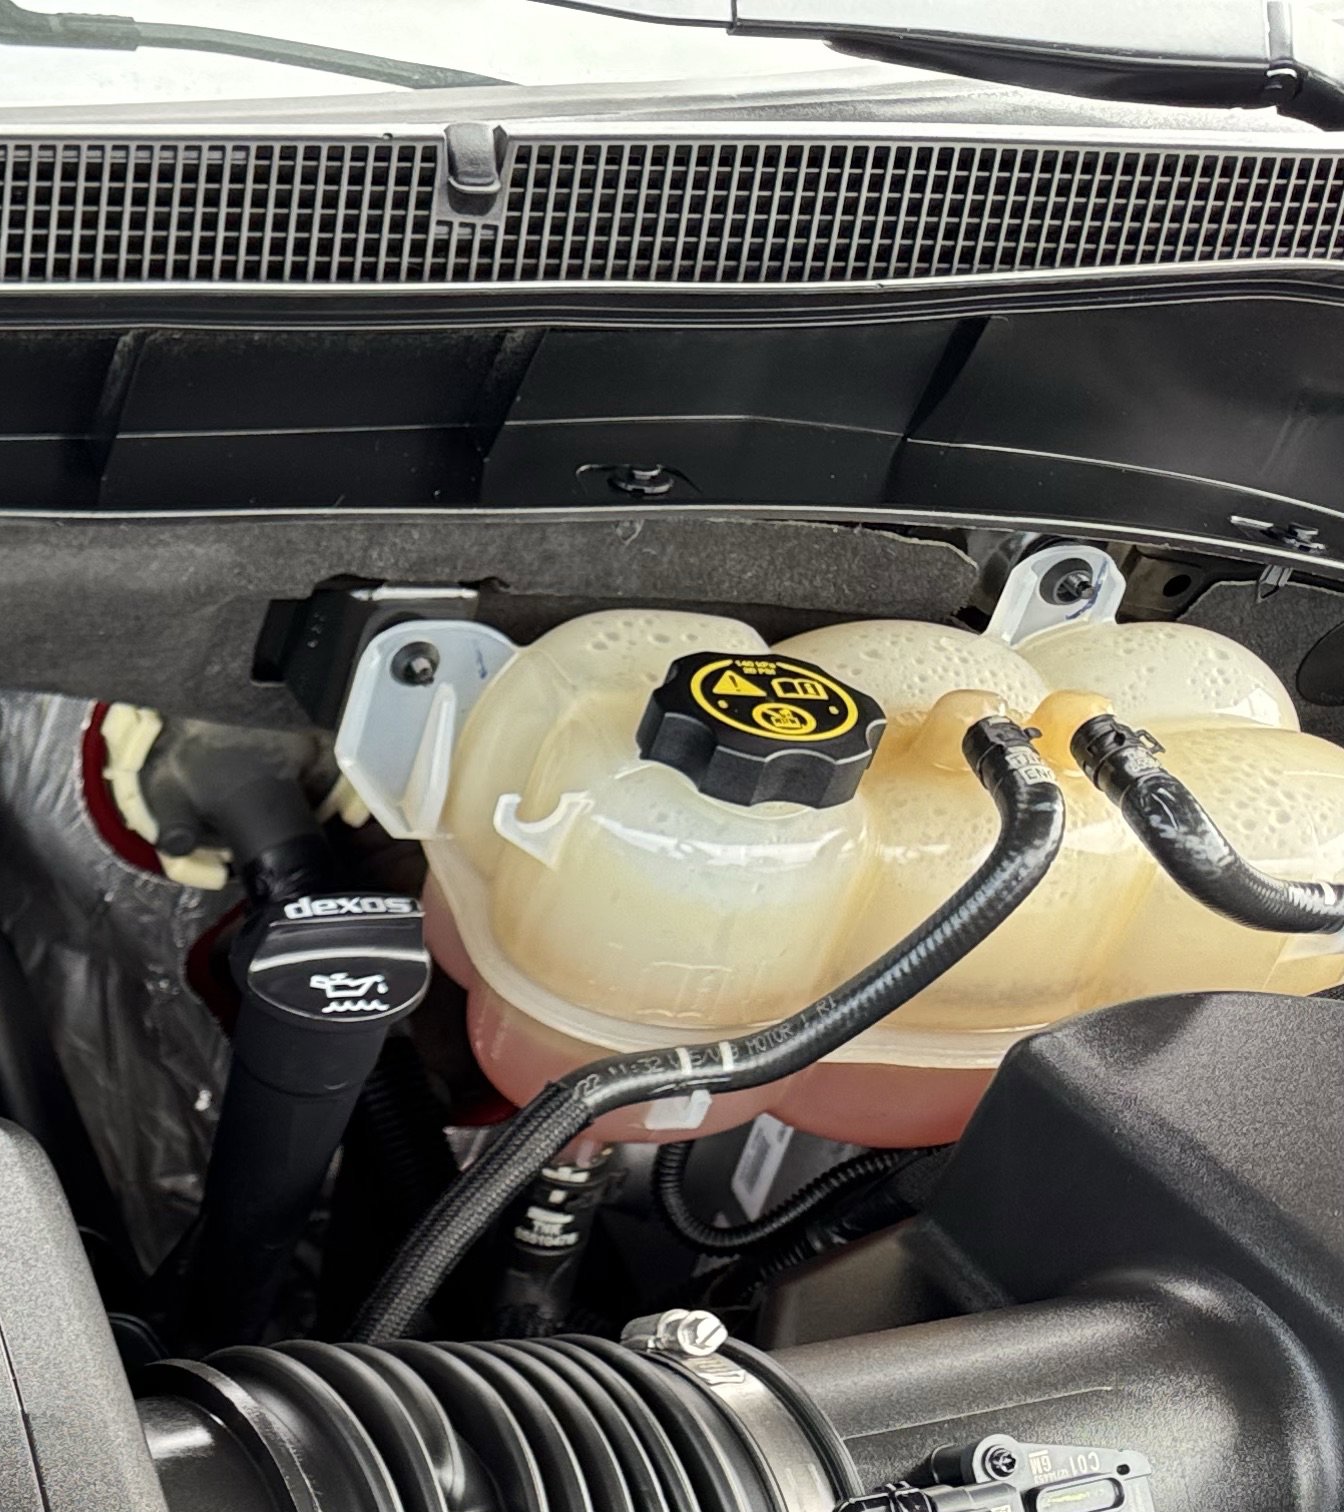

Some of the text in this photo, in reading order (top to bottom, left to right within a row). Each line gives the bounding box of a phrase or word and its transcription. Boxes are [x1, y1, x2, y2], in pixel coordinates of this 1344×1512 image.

[283, 896, 412, 919] dexos
[745, 1024, 794, 1055] MOTOR
[1029, 1454, 1053, 1475] GM
